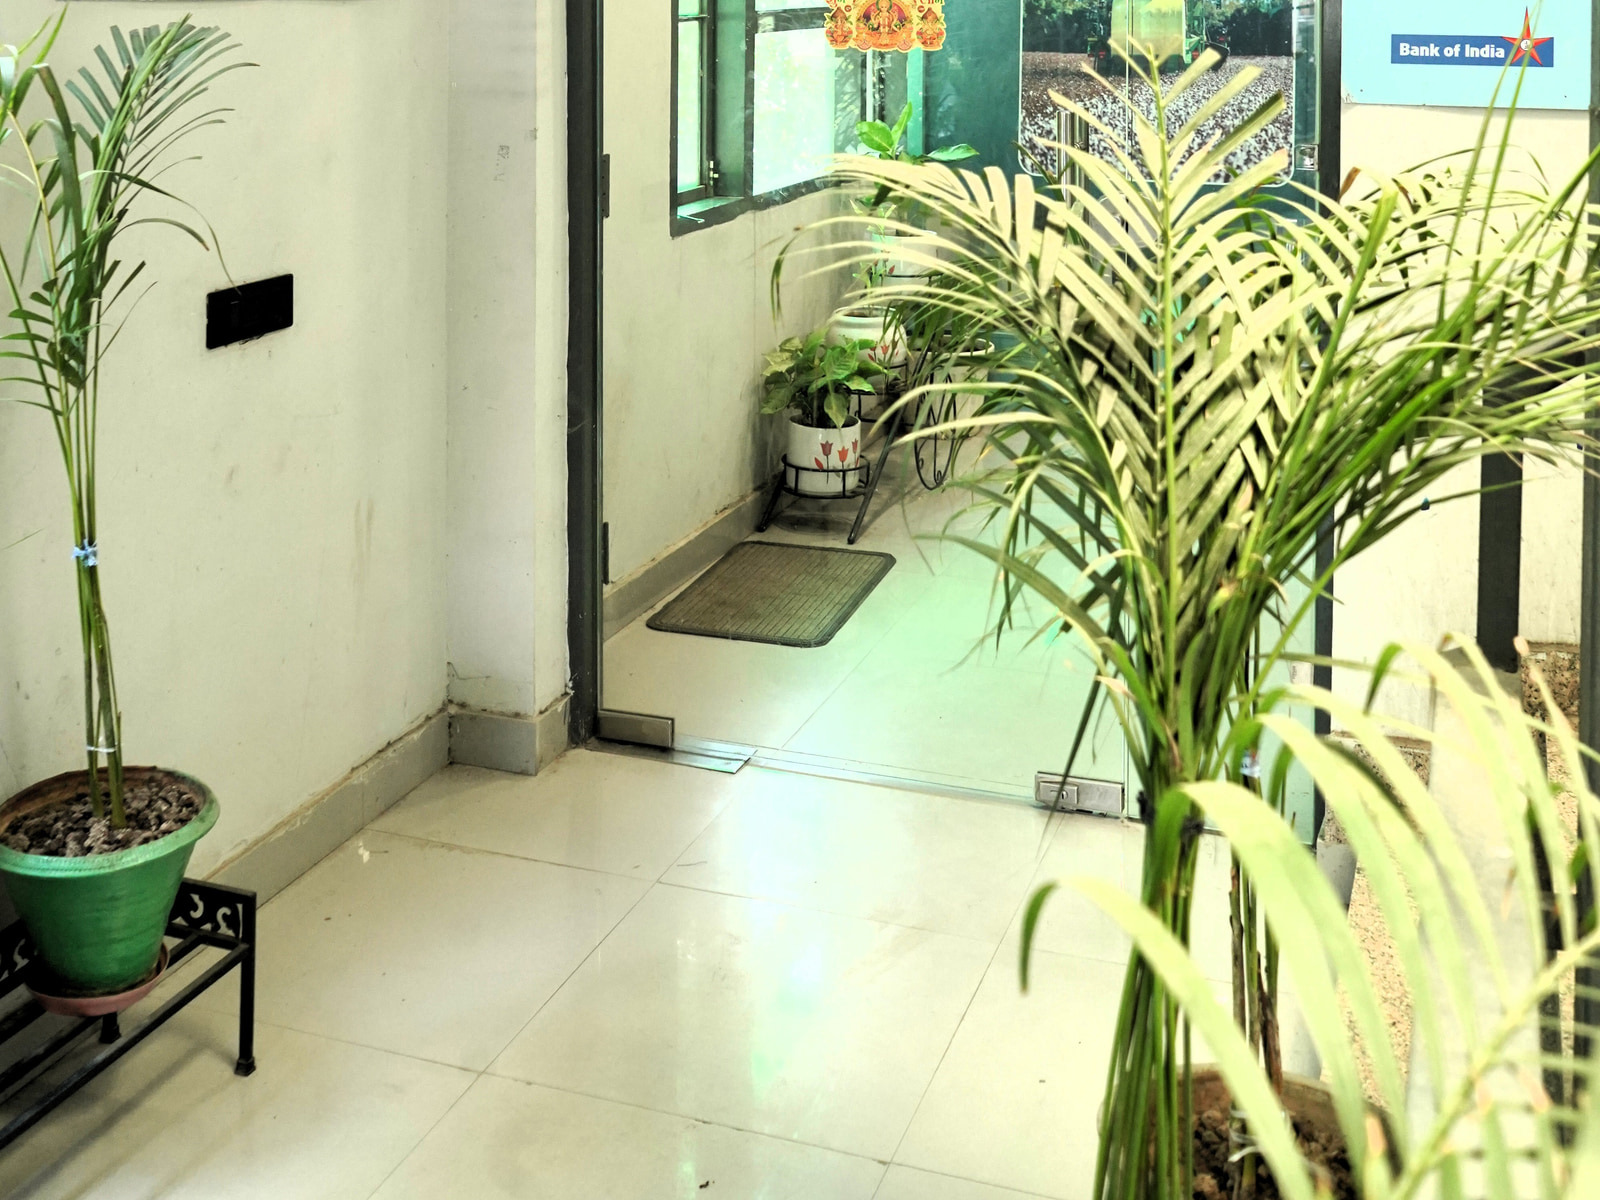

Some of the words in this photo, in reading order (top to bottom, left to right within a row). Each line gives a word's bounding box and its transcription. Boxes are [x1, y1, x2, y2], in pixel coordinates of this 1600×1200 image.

[1399, 42, 1441, 57] Bank
[1443, 43, 1461, 58] of
[1465, 44, 1505, 58] India
